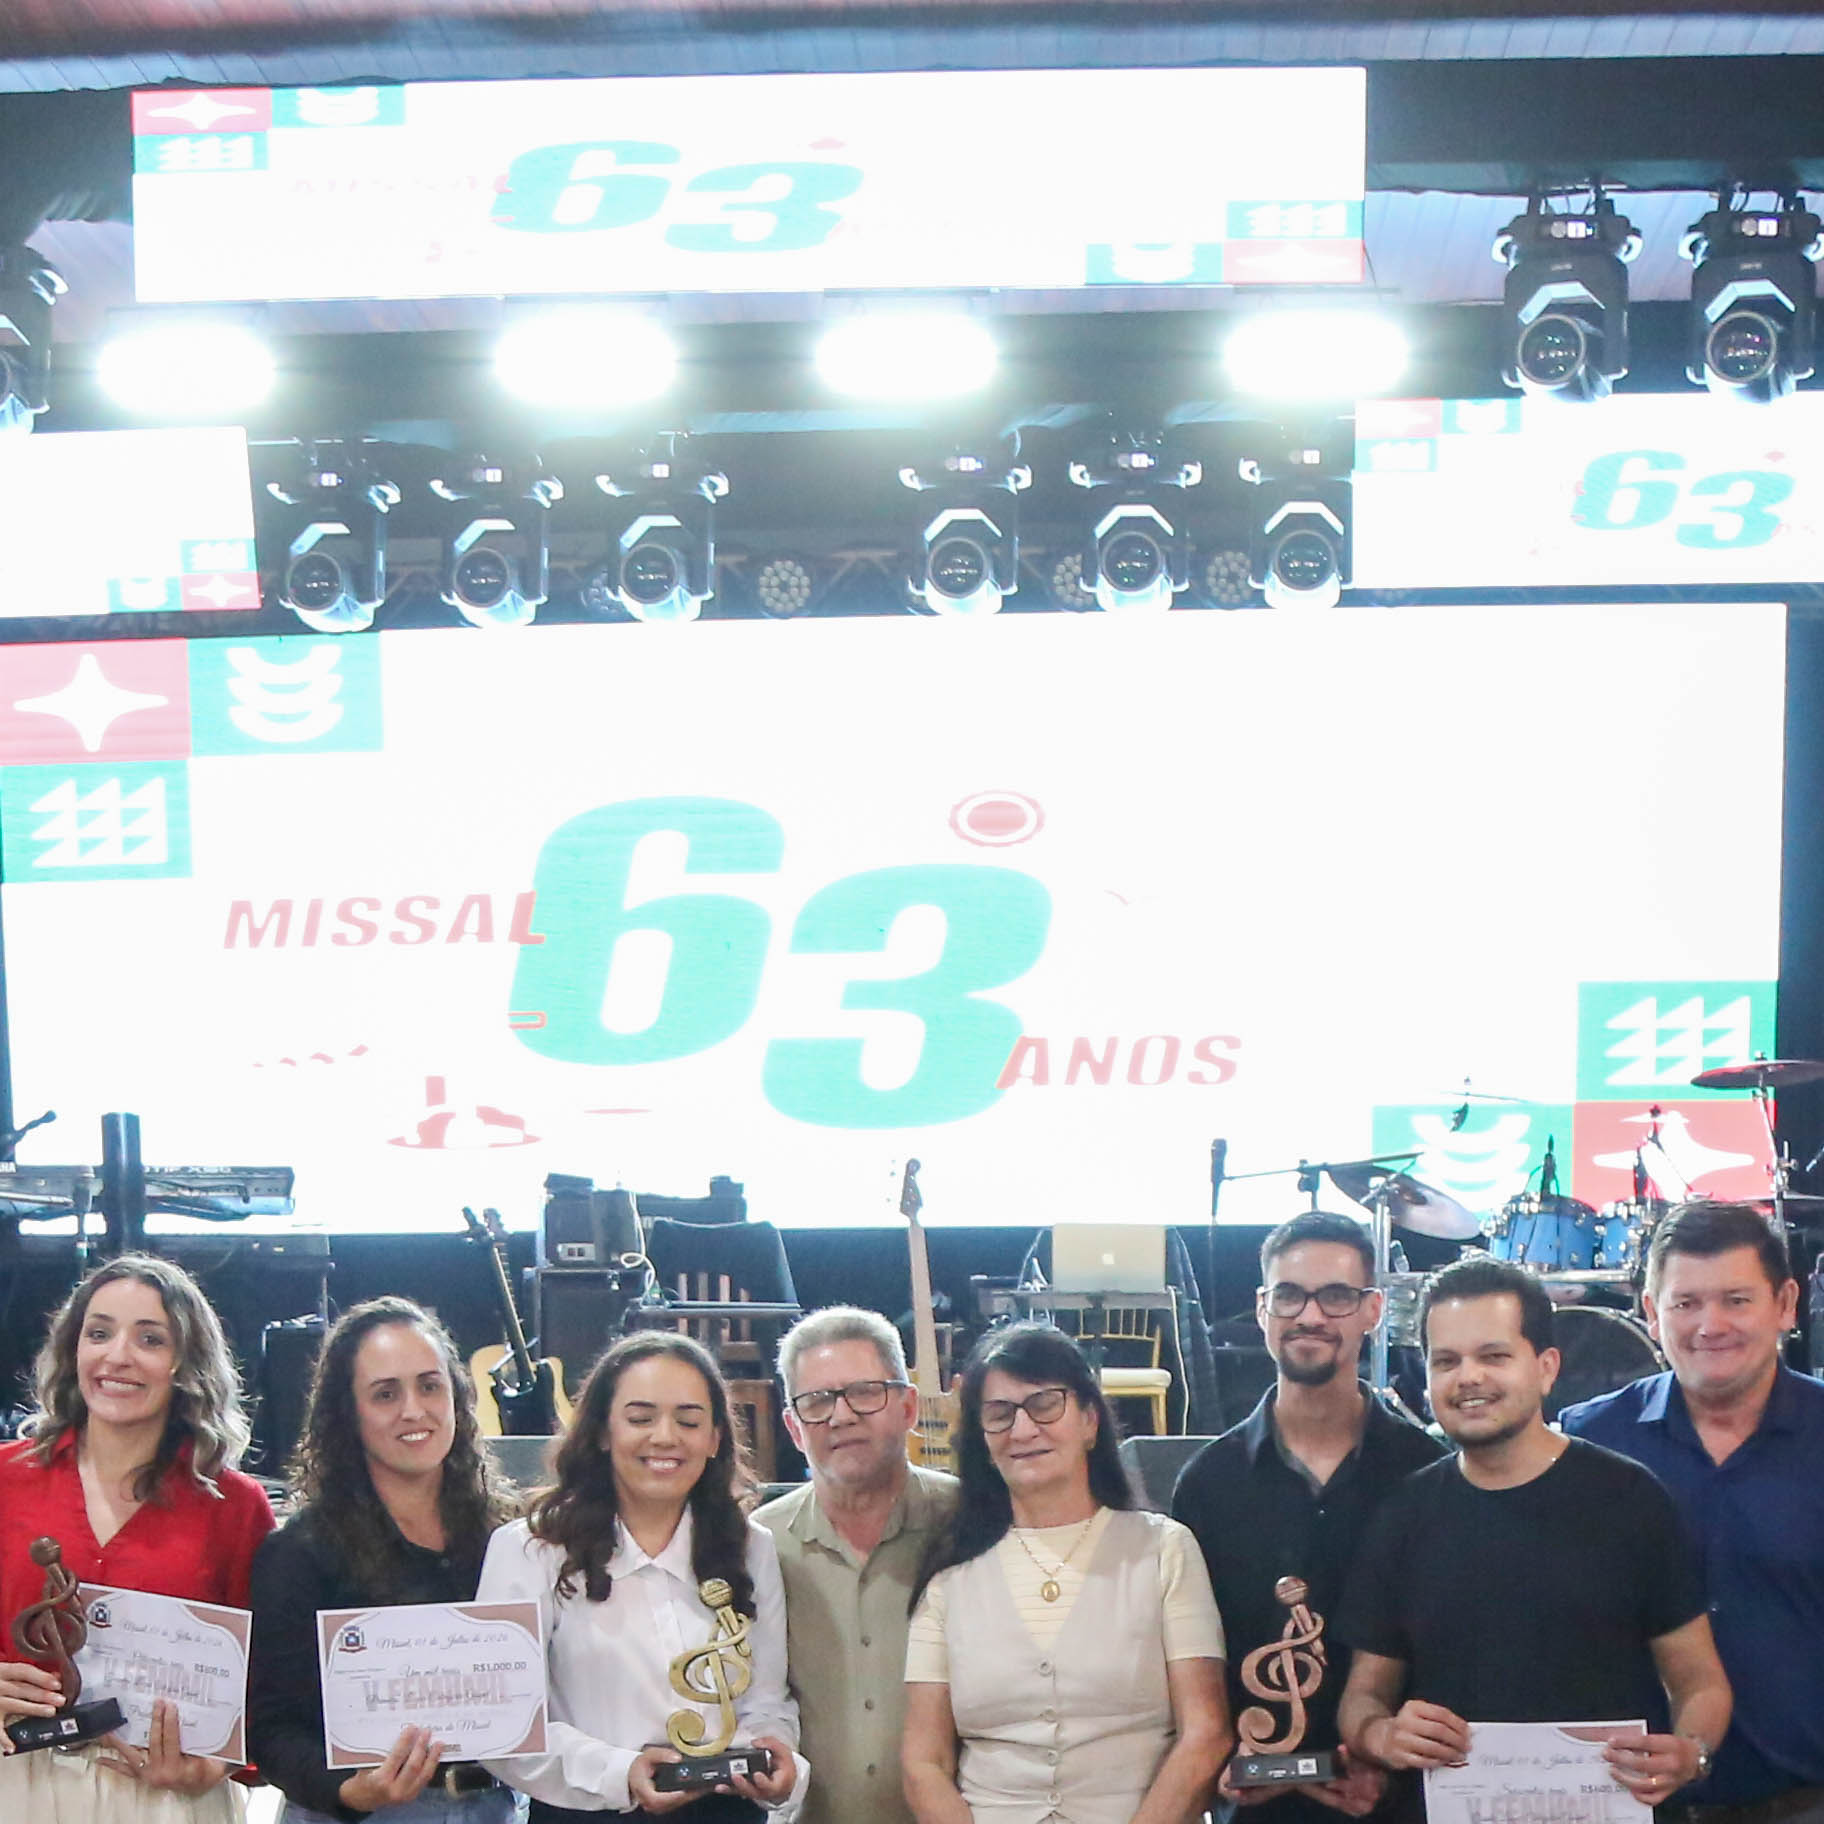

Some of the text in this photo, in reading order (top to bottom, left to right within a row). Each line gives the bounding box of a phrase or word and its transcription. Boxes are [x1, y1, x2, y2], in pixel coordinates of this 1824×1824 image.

[492, 140, 863, 253] 63
[1572, 449, 1794, 549] 63
[222, 889, 546, 949] MISSAL
[996, 1034, 1242, 1088] ANOS
